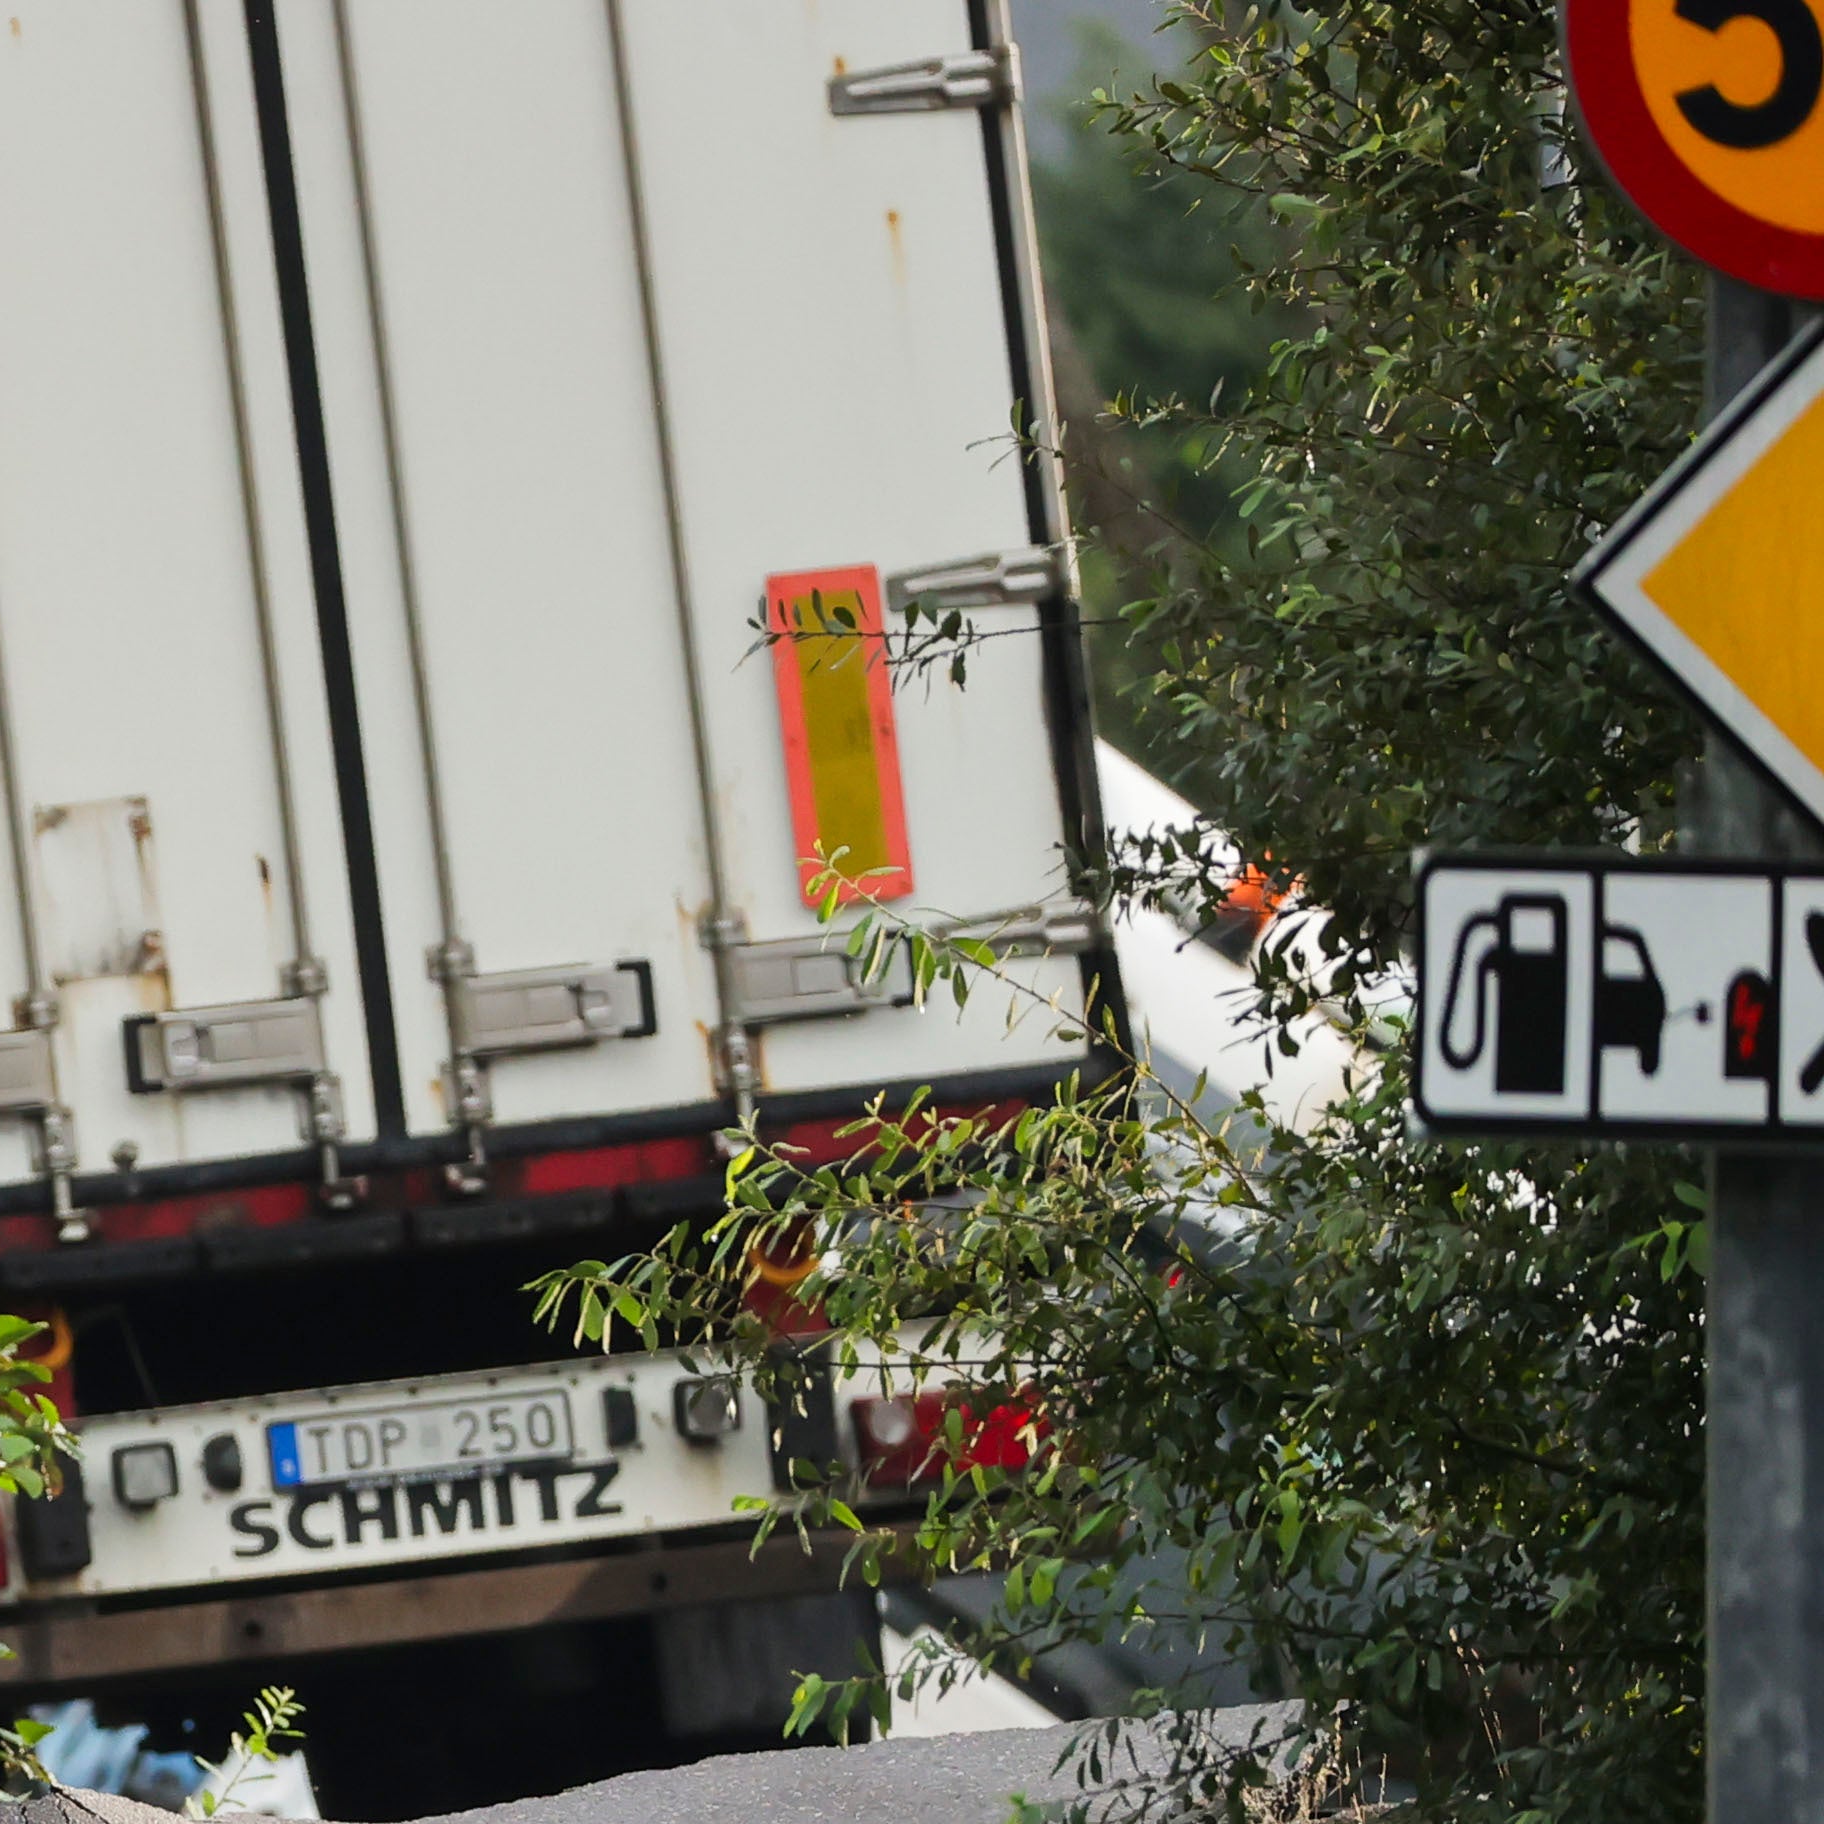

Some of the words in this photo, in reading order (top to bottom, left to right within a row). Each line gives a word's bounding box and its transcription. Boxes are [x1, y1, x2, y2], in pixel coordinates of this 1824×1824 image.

[306, 1417, 407, 1474] TDP
[453, 1401, 553, 1457] 250
[229, 1462, 623, 1557] SCHMITZ
